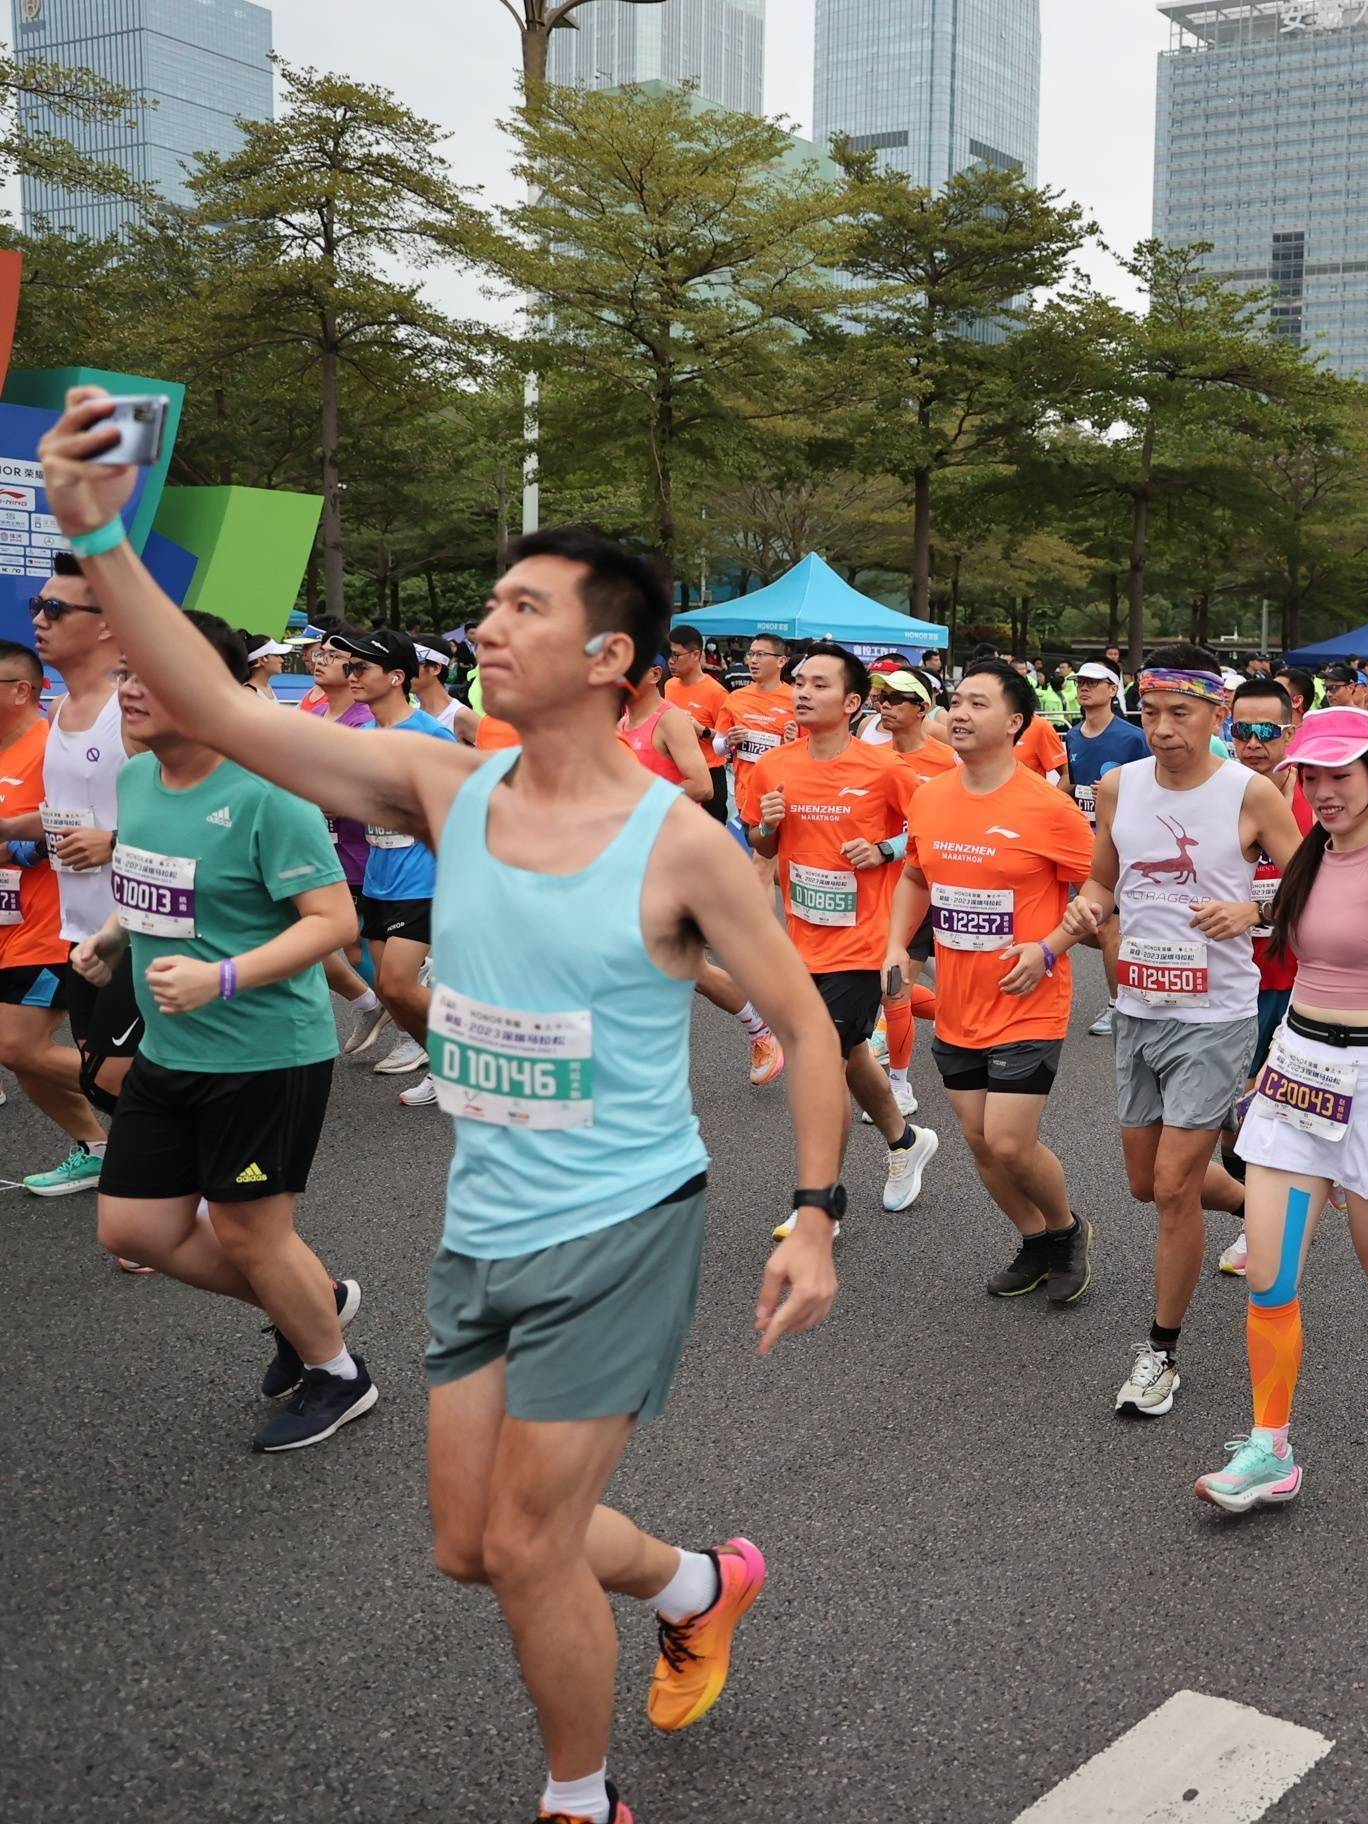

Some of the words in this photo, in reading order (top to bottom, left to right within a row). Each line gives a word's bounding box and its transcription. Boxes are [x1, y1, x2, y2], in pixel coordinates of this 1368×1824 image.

[757, 622, 778, 631] HONOR
[904, 631, 928, 640] HONOR
[790, 804, 851, 814] SHENZHEN
[801, 814, 840, 822] MARATHON
[932, 840, 997, 857] SHENZHEN
[941, 852, 984, 864] MARATHON
[113, 874, 121, 900] C
[122, 879, 172, 914] 10013
[796, 887, 803, 903] D
[803, 888, 846, 911] 10865
[940, 910, 949, 929] C
[952, 911, 1001, 934] 12257
[1129, 965, 1139, 986] A
[1142, 966, 1194, 991] 12450
[469, 1010, 503, 1025] HONOR
[442, 1041, 461, 1081] D
[466, 1049, 557, 1098] 10146
[1264, 1071, 1278, 1096] C
[1275, 1077, 1335, 1117] 20043
[235, 1173, 268, 1184] adidas
